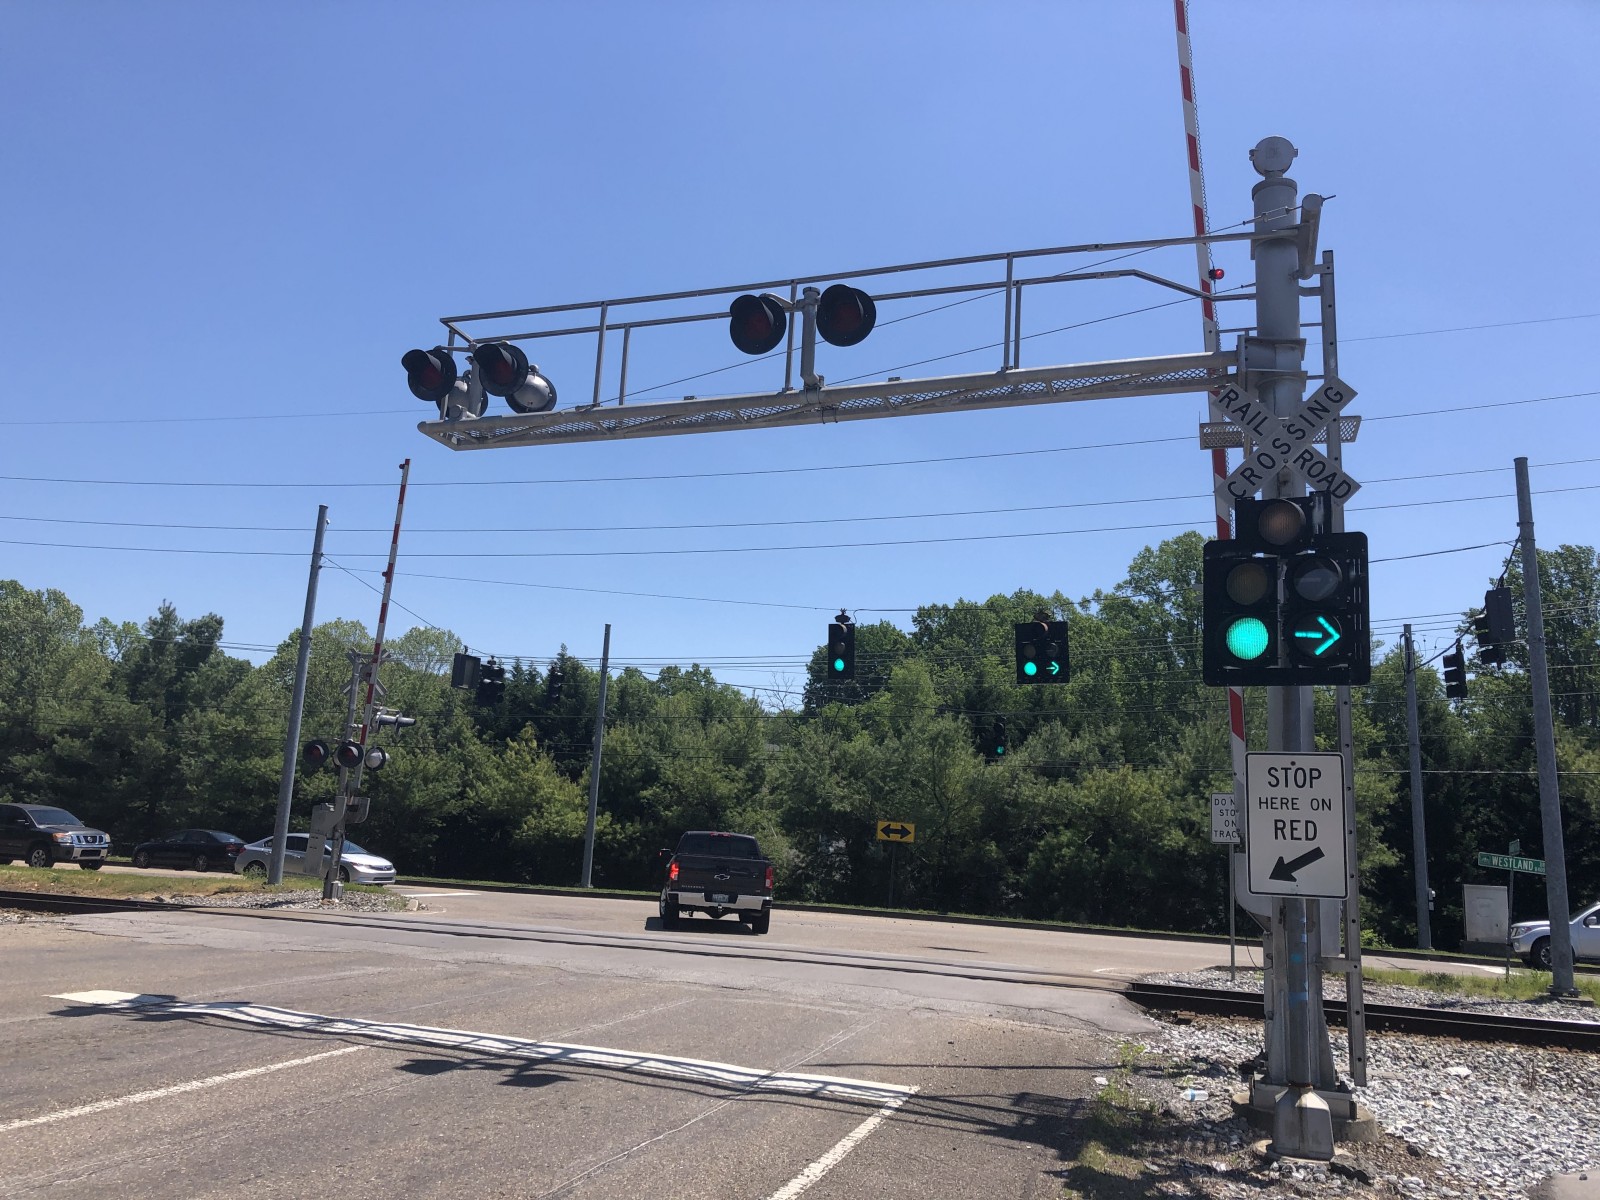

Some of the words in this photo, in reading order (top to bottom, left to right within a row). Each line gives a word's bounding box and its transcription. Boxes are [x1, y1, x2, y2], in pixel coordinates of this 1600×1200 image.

[1218, 389, 1268, 437] RAIL
[1293, 448, 1352, 499] ROAD
[1227, 386, 1343, 499] CROSSING
[1267, 767, 1322, 789] STOP
[1214, 798, 1227, 806] DO
[1258, 797, 1300, 811] HERE
[1310, 798, 1332, 811] ON
[1219, 809, 1236, 817] STO
[1213, 830, 1239, 838] TRAC
[1274, 819, 1318, 841] RED
[1492, 855, 1534, 871] WESTLAND
